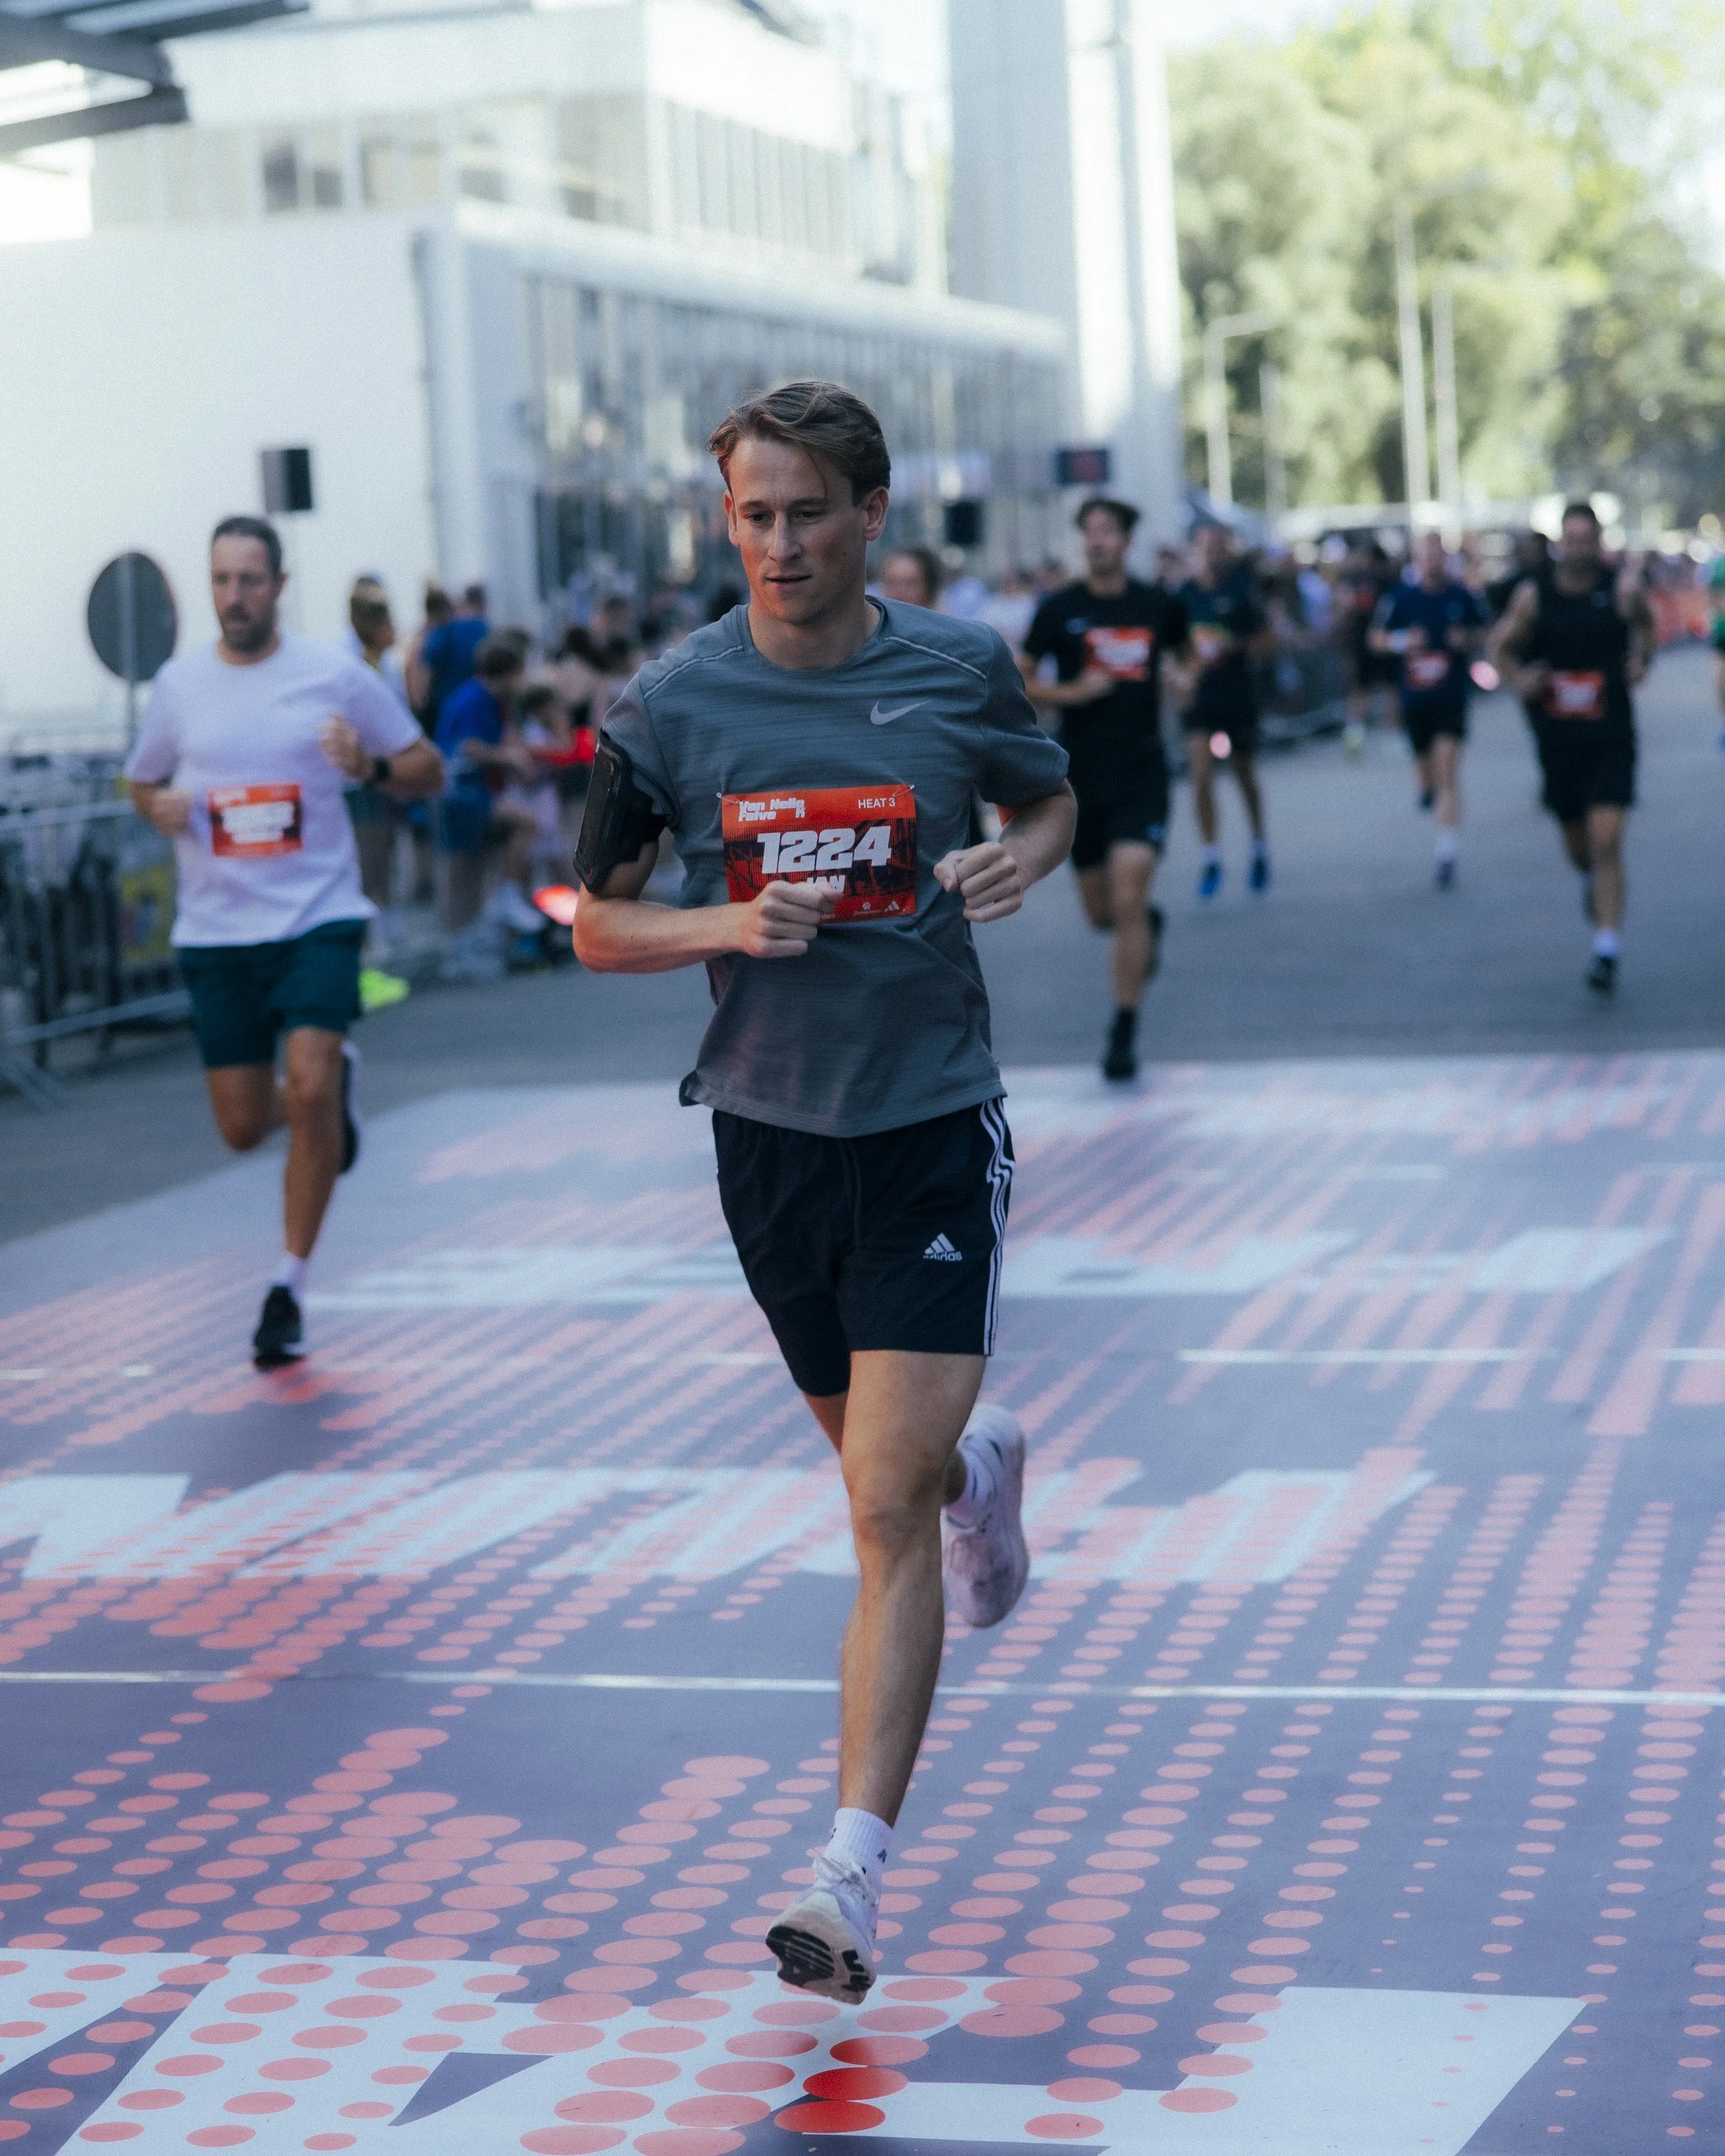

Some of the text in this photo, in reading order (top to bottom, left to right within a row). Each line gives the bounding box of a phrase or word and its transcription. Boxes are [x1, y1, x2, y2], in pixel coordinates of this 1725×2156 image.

[739, 801, 765, 811] Van
[858, 798, 896, 808] HEAT 3
[757, 826, 891, 874] 1224
